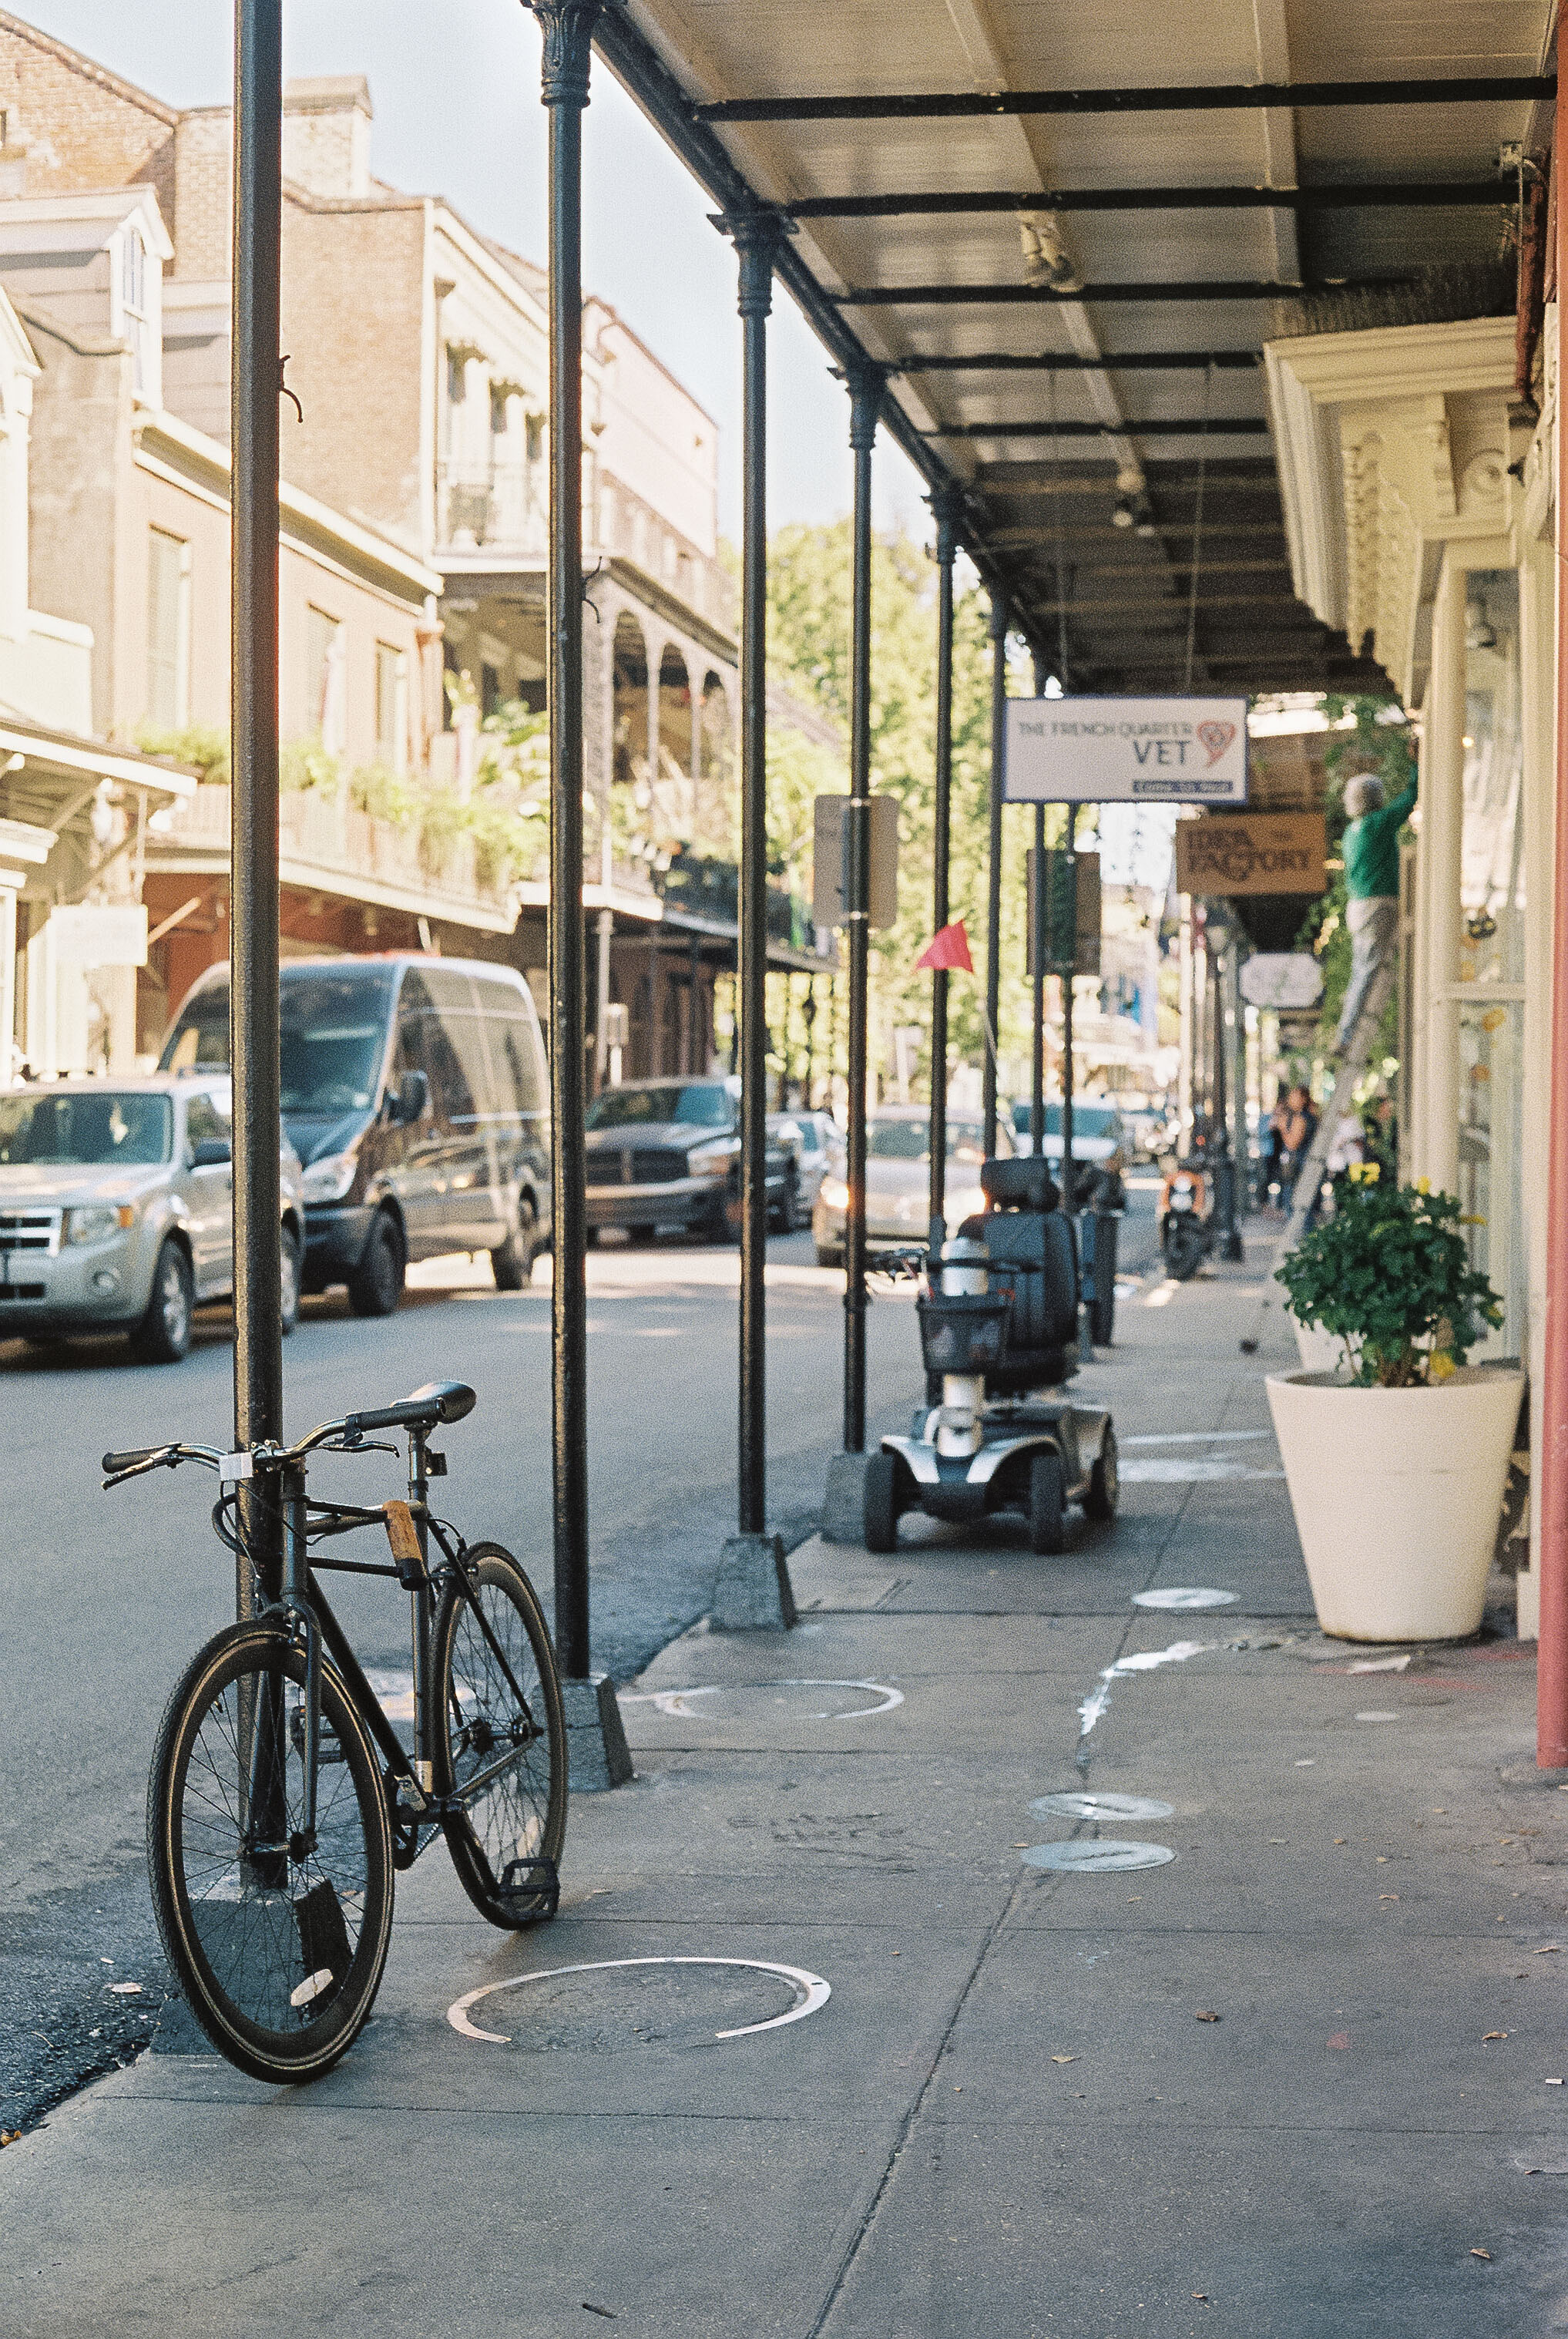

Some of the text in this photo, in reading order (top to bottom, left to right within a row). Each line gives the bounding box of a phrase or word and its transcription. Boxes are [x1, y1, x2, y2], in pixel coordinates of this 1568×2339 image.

[1051, 722, 1116, 735] FRENCH
[1119, 722, 1193, 737] QUARTER
[1133, 740, 1190, 765] VET
